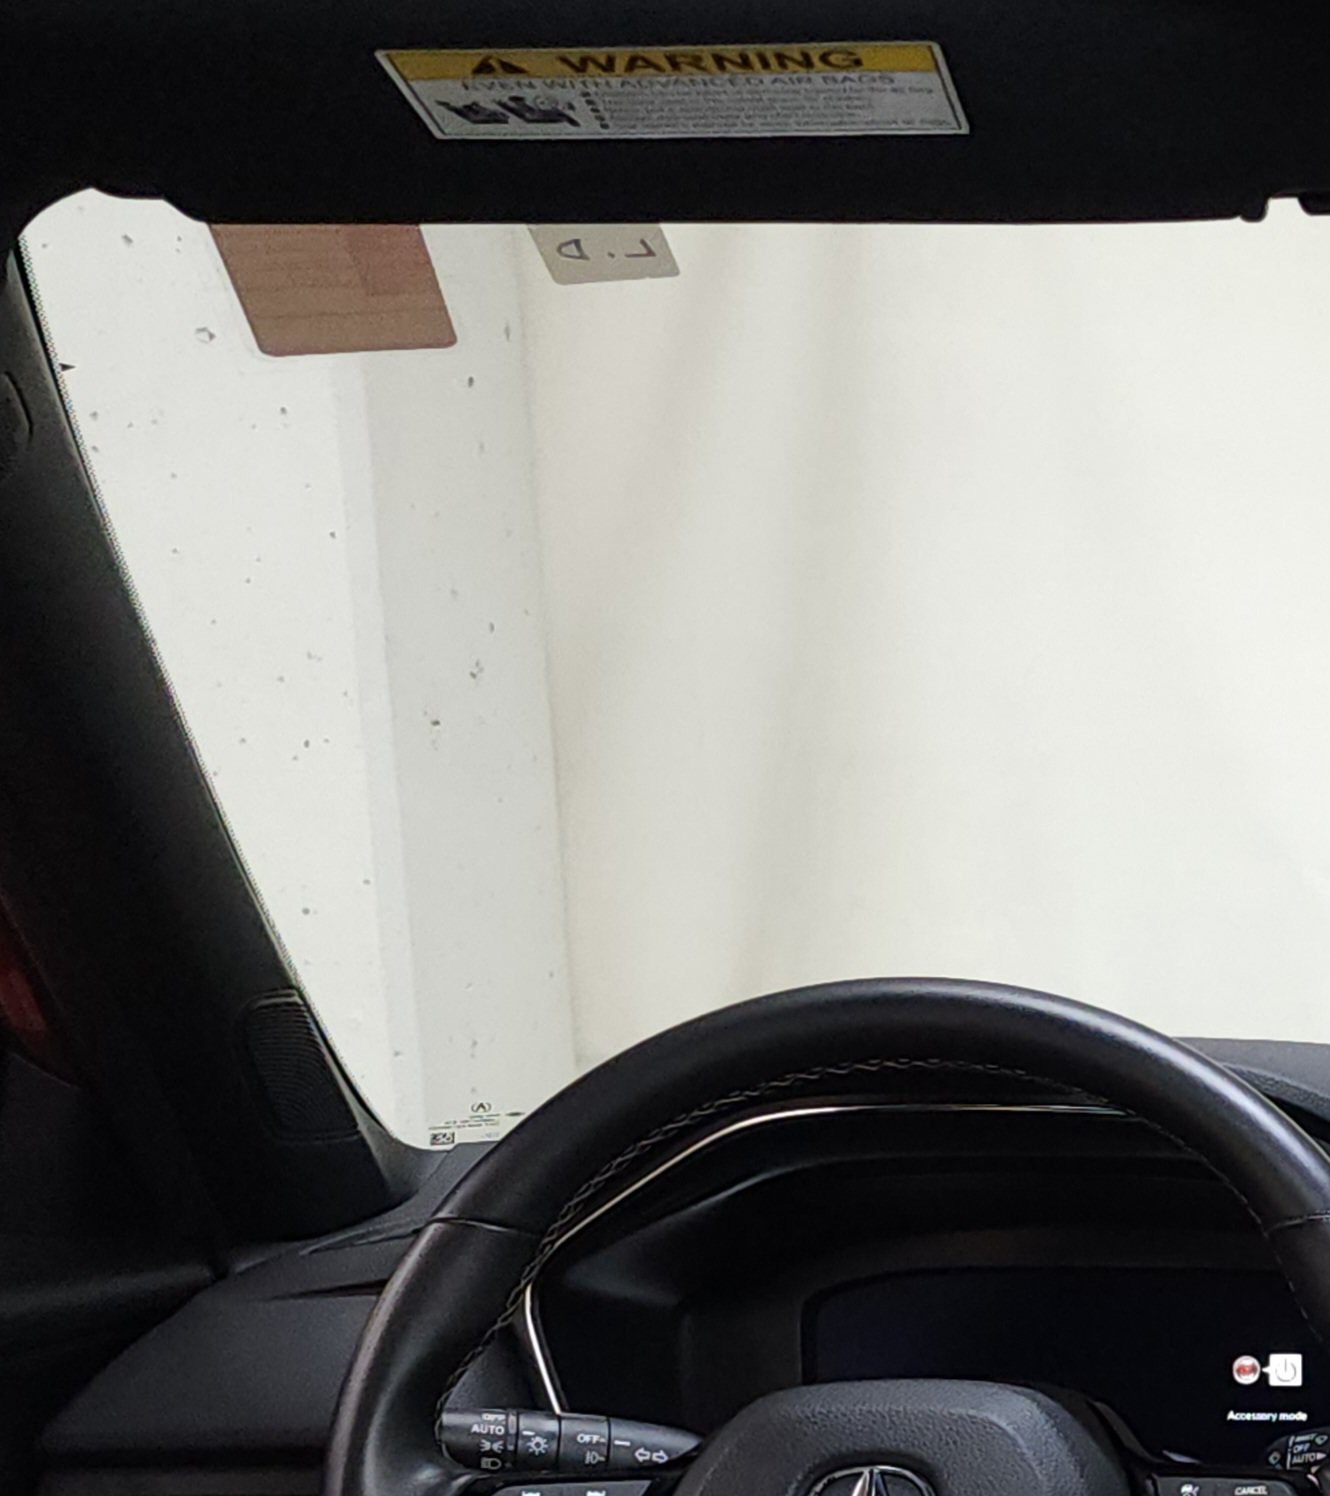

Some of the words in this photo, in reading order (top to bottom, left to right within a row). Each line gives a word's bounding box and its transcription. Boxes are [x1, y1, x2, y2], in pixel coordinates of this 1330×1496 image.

[556, 50, 864, 73] WARNING
[543, 78, 613, 90] WITH
[620, 76, 763, 89] ADVANCED
[770, 76, 812, 86] AIR
[821, 74, 895, 85] BAGS
[1227, 1410, 1277, 1422] Accessory
[1279, 1411, 1308, 1421] mode
[471, 1424, 505, 1435] AUTO
[577, 1434, 599, 1444] OFF
[1293, 1443, 1311, 1453] OFF
[1292, 1452, 1316, 1464] AUTO
[1235, 1485, 1267, 1496] CANCEL
